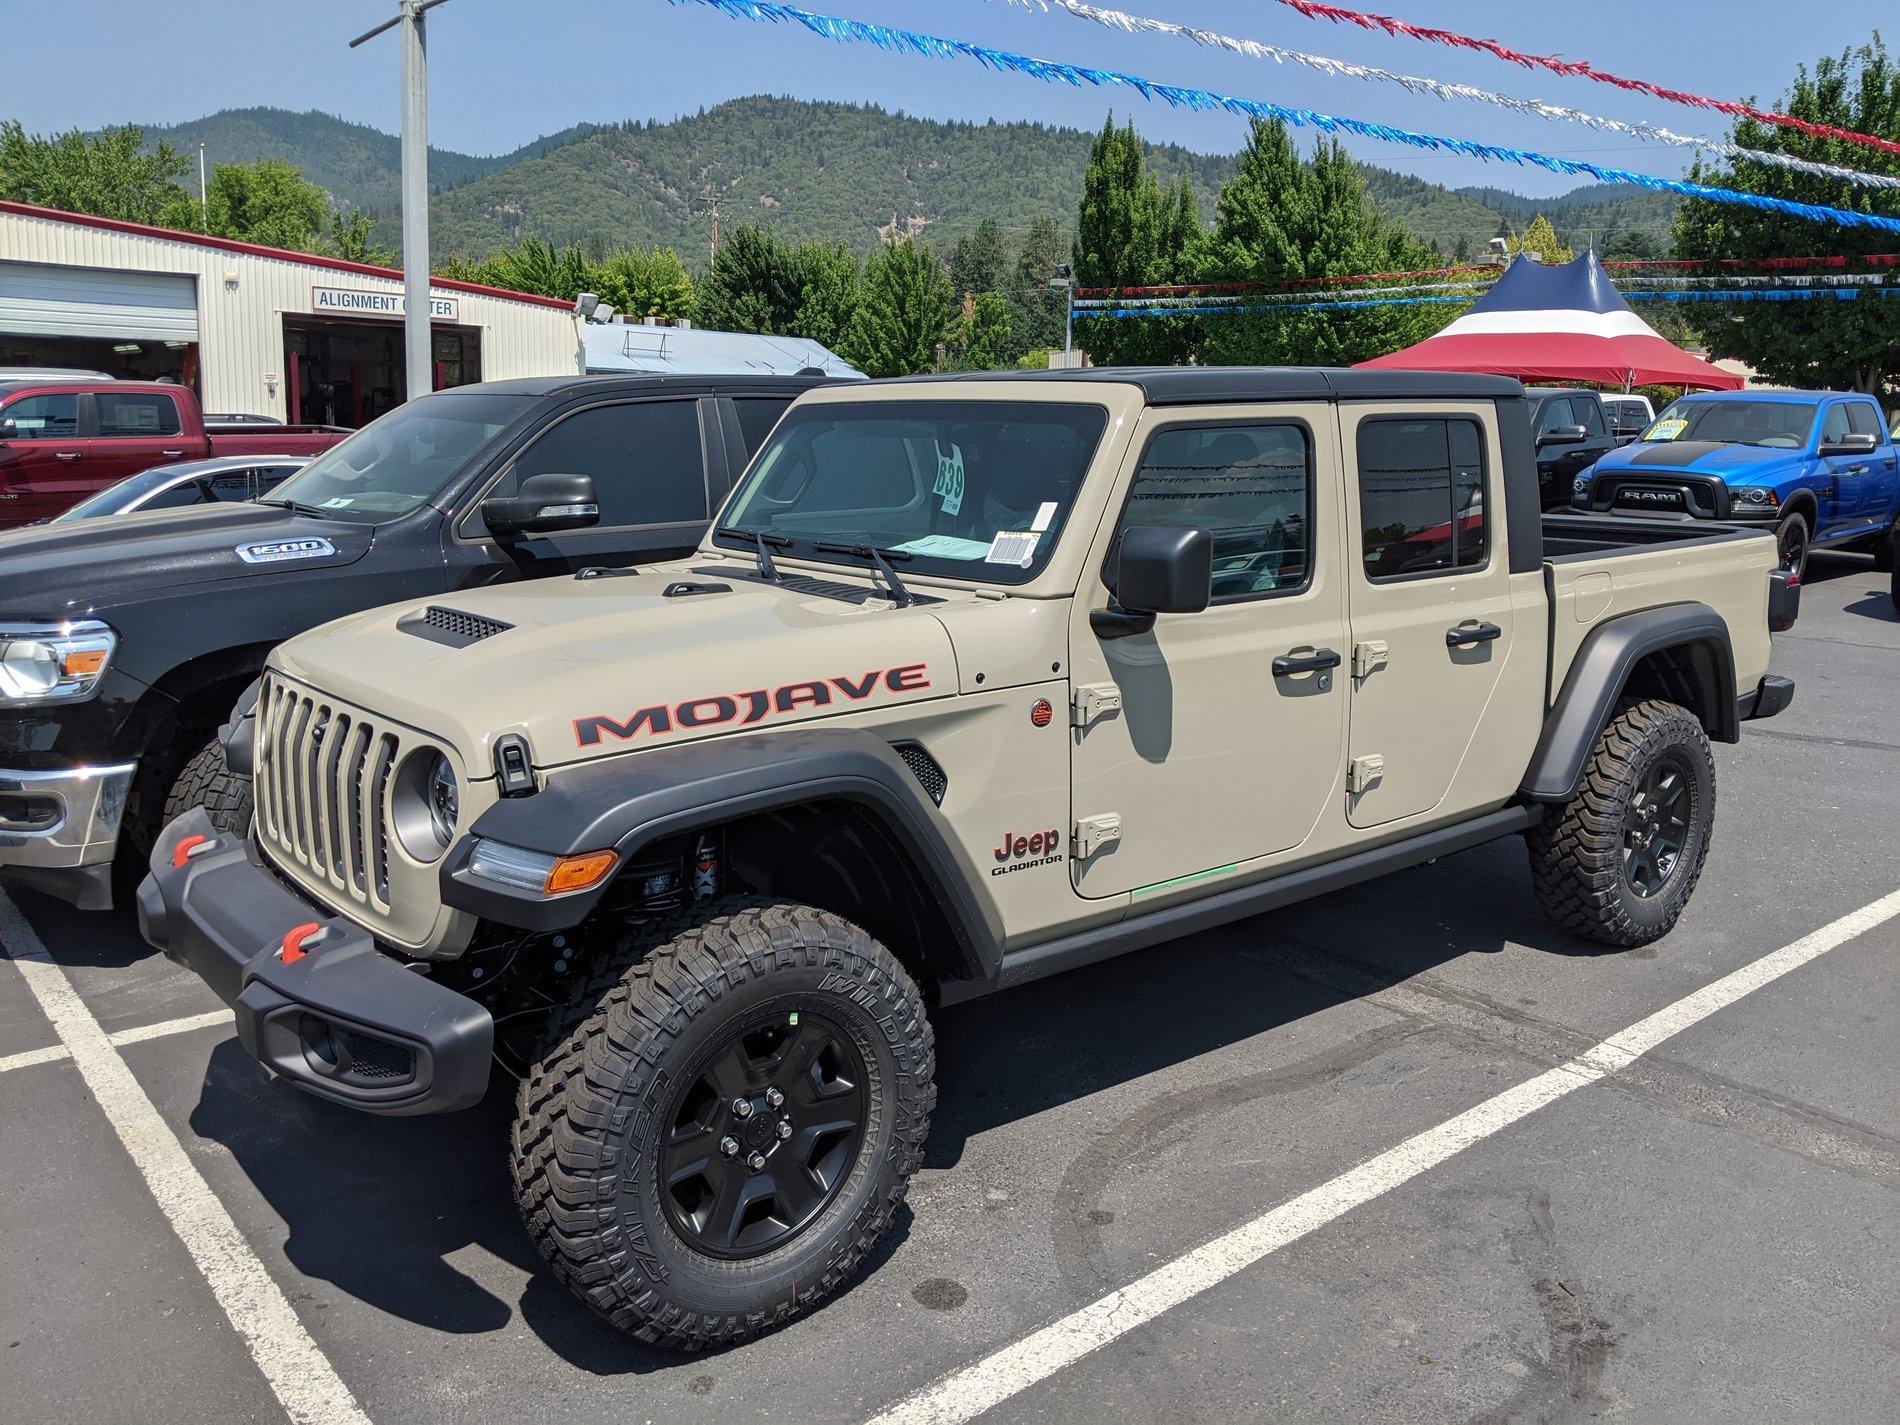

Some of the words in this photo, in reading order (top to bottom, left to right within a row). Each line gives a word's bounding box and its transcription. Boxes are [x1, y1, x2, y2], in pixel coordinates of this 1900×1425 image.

[319, 291, 398, 311] ALIGNMENT
[1624, 490, 1677, 501] RAM
[251, 541, 319, 555] 1500
[571, 663, 932, 749] MOJAVE
[994, 829, 1060, 863] Jeep
[991, 855, 1063, 876] GLADIATOR
